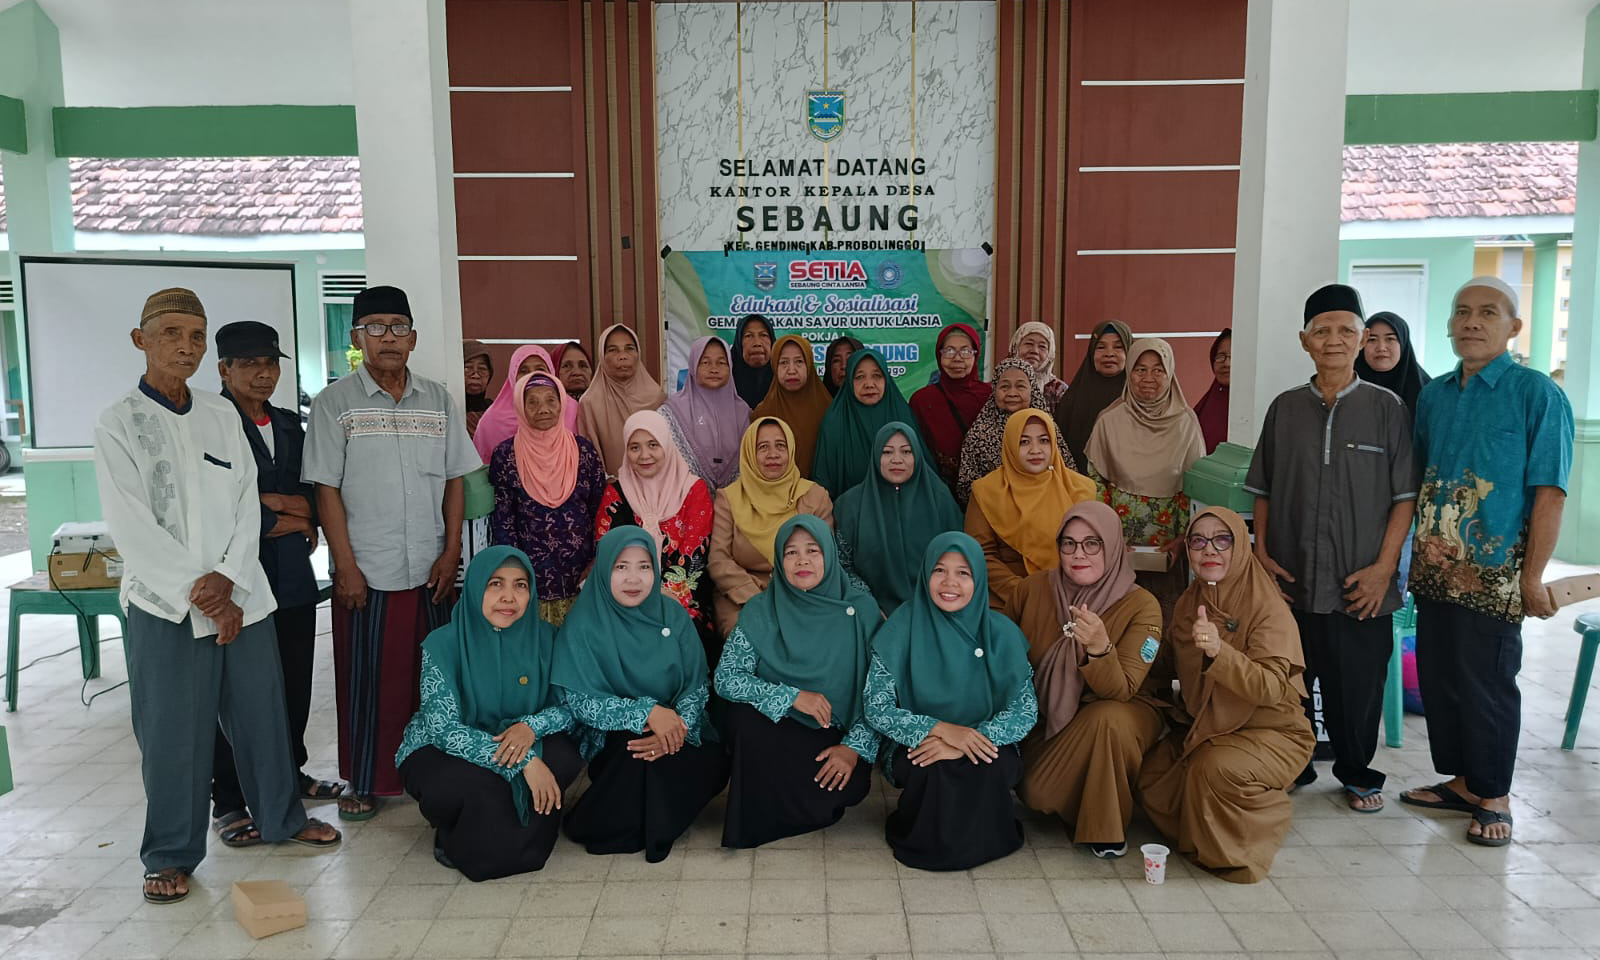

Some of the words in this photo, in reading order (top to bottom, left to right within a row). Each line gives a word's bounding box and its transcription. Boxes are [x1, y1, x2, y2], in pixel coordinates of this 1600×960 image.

[719, 159, 825, 177] SELAMAT
[836, 158, 927, 176] DATANG
[710, 186, 791, 198] KANTOR
[804, 185, 879, 197] KEPALA
[886, 185, 935, 196] DESA
[736, 205, 919, 232] SEBAUNG
[789, 261, 866, 279] SETIA
[730, 295, 802, 313] Edukasi
[804, 295, 820, 312] &
[824, 294, 918, 313] Sosialisasi
[708, 317, 738, 328] GEM
[768, 317, 803, 327] AKAN
[806, 317, 848, 327] SAYUR
[850, 316, 893, 327] UNTUK
[895, 315, 941, 326] LANSIA
[801, 332, 840, 341] POKJA
